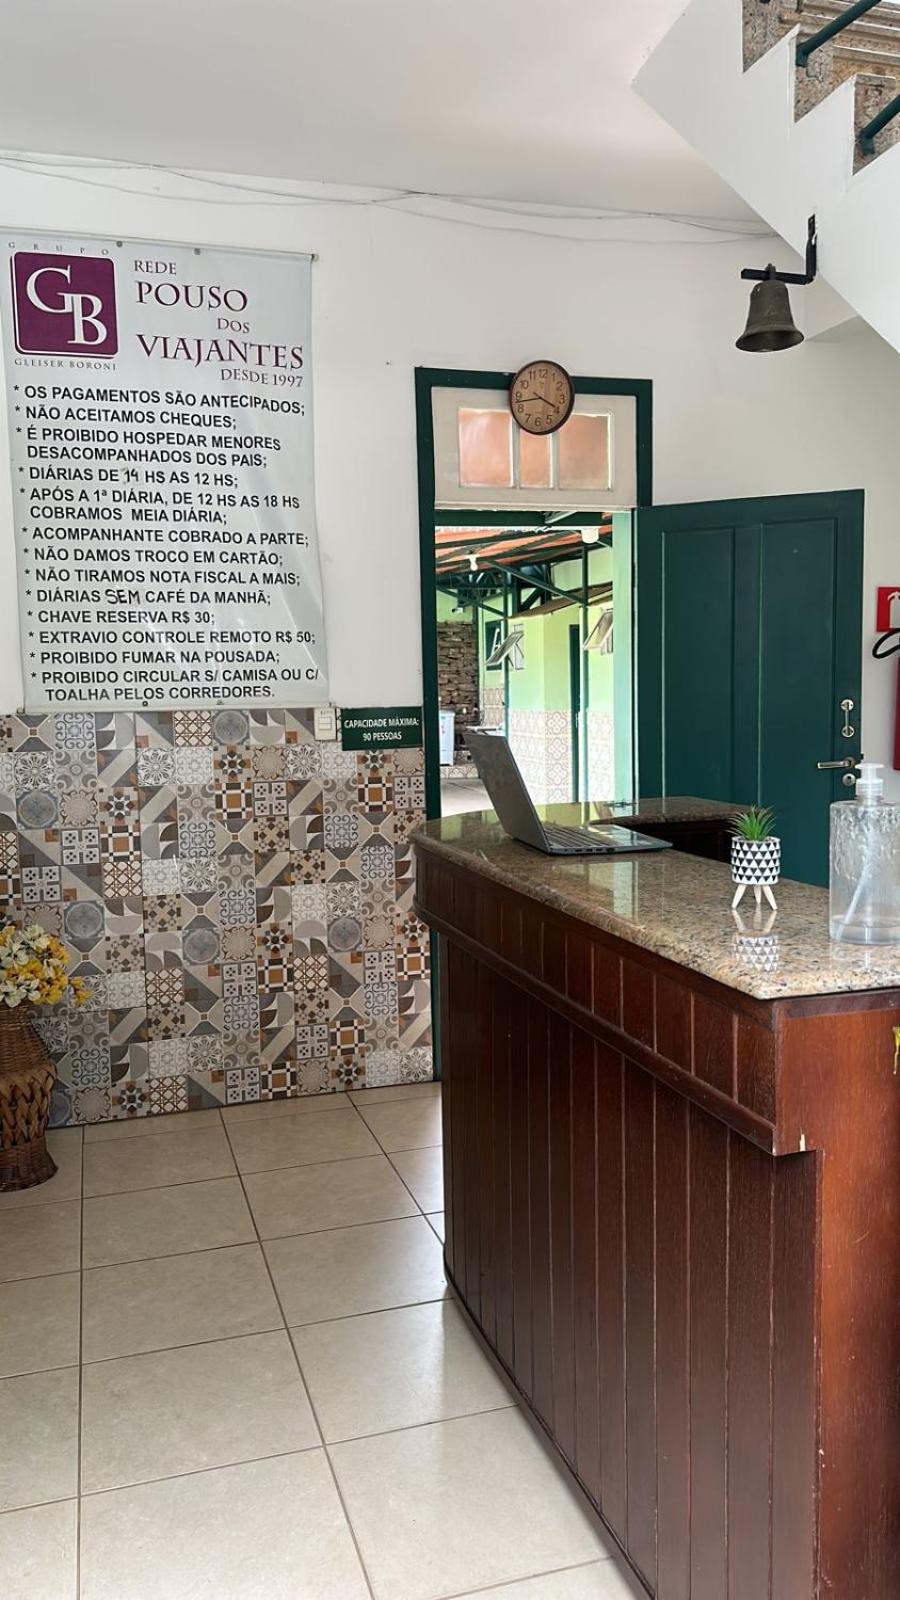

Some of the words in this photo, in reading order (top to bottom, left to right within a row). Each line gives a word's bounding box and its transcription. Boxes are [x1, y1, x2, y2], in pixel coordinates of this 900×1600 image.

[134, 260, 176, 275] REDE
[135, 281, 248, 312] POUSO
[26, 264, 107, 345] GB
[217, 318, 250, 333] DOS
[136, 334, 303, 369] VIAJANTES
[14, 358, 63, 368] GLEISER
[69, 361, 116, 371] BORONI
[221, 369, 268, 384] DESDE
[273, 374, 303, 388] 1997
[529, 371, 536, 380] 11
[539, 369, 547, 378] 12
[552, 373, 555, 381] 1
[520, 380, 528, 389] 10
[556, 382, 562, 391] 2
[24, 386, 47, 398] OS
[52, 386, 160, 403] PAGAMENTOS
[165, 391, 196, 406] SÃO
[201, 395, 305, 415] ANTECIPADOS;
[516, 392, 521, 400] 9
[559, 395, 564, 404] 3
[518, 404, 524, 413] 8
[26, 406, 60, 420] NÃO
[65, 408, 155, 423] ACEITAMOS
[160, 411, 236, 429] CHEQUES;
[525, 413, 531, 423] 7
[535, 417, 541, 426] 6
[546, 415, 552, 425] 5
[28, 425, 37, 440] É
[43, 429, 118, 444] PROIBIDO
[124, 432, 206, 447] HOSPEDAR
[212, 436, 281, 450] MENORES
[28, 446, 191, 463] DESACOMPANHADOS
[197, 453, 226, 465] DOS
[232, 454, 266, 467] PAIS;
[29, 467, 93, 481] DIÁRIAS
[99, 470, 119, 482] DE
[124, 468, 139, 482] 14
[145, 471, 165, 483] HS
[169, 472, 189, 484] AS
[195, 473, 209, 485] 12
[214, 474, 237, 488] HS;
[30, 487, 74, 501] APÓS
[79, 490, 89, 501] A
[93, 490, 107, 502] 1ª
[112, 490, 168, 505] DIÁRIA,
[174, 492, 192, 504] DE
[198, 494, 212, 505] 12
[217, 494, 236, 506] HS
[240, 495, 259, 507] AS
[263, 495, 278, 507] 18
[282, 496, 300, 509] HS
[30, 506, 122, 521] COBRAMOS
[132, 509, 168, 521] MEIA
[173, 509, 227, 525] DIÁRIA;
[32, 527, 163, 542] ACOMPANHANTE
[168, 530, 242, 544] COBRADO
[246, 532, 256, 544] A
[260, 533, 308, 546] PARTE;
[34, 547, 69, 560] NÃO
[74, 549, 130, 562] DAMOS
[135, 550, 189, 562] TROCO
[194, 551, 215, 563] EM
[219, 551, 283, 566] CARTÃO;
[36, 568, 70, 581] NÃO
[75, 570, 145, 583] TIRAMOS
[150, 571, 191, 583] NOTA
[195, 572, 245, 584] FISCAL
[249, 573, 259, 584] A
[263, 573, 300, 586] MAIS;
[37, 587, 100, 602] DIÁRIAS
[105, 588, 140, 604] SEM
[145, 589, 185, 603] CAFÉ
[190, 592, 210, 603] DA
[215, 591, 270, 605] MANHÃ;
[38, 611, 92, 623] CHAVE
[96, 611, 167, 623] RESERVA
[172, 610, 190, 624] R$
[195, 611, 215, 625] 30;
[40, 631, 117, 643] EXTRAVIO
[122, 631, 205, 643] CONTROLE
[210, 631, 271, 643] REMOTO
[276, 630, 292, 644] R$
[296, 631, 315, 645] 50;
[41, 651, 117, 664] PROIBIDO
[122, 651, 175, 664] FUMAR
[181, 651, 200, 663] NA
[205, 651, 280, 664] POUSADA;
[42, 671, 118, 684] PROIBIDO
[123, 670, 200, 683] CIRCULAR
[205, 670, 218, 682] S/
[222, 669, 276, 681] CAMISA
[281, 668, 301, 680] OU
[305, 668, 318, 680] C/
[46, 689, 109, 701] TOALHA
[114, 687, 165, 700] PELOS
[169, 686, 275, 699] CORREDORES.
[344, 719, 387, 728] CAPACIDADE
[389, 717, 419, 726] MÁXIMA:
[363, 733, 371, 741] 90
[373, 732, 402, 741] PESSOAS
